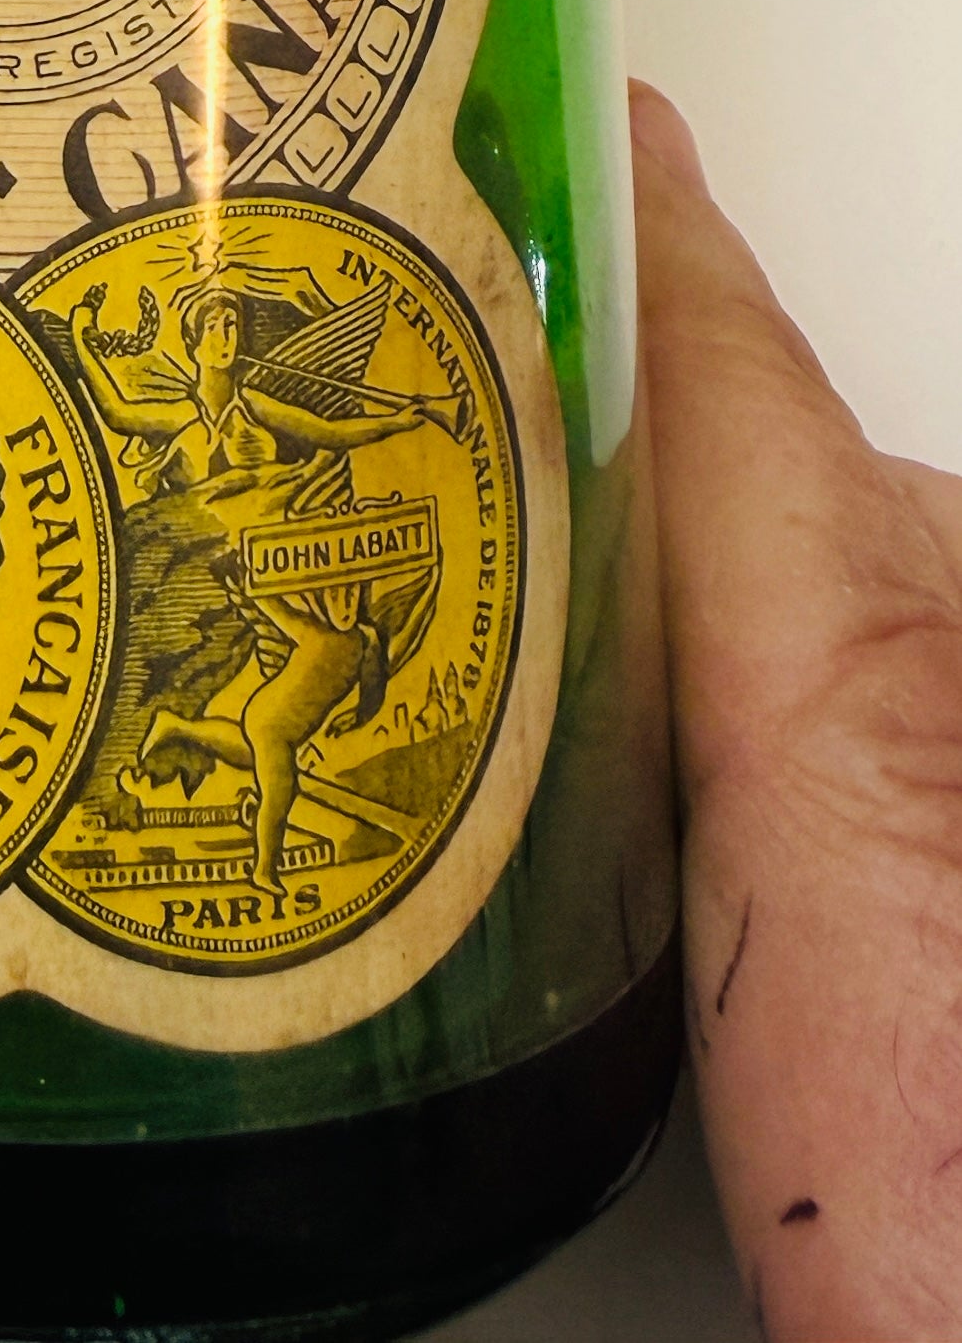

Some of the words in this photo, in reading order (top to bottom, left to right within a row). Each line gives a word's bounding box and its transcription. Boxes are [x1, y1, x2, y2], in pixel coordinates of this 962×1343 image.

[336, 248, 497, 528] INTERNATINALE
[478, 538, 498, 591] DE
[255, 541, 331, 575] JOHN
[339, 521, 425, 564] LABATT
[160, 883, 322, 930] PARIS
